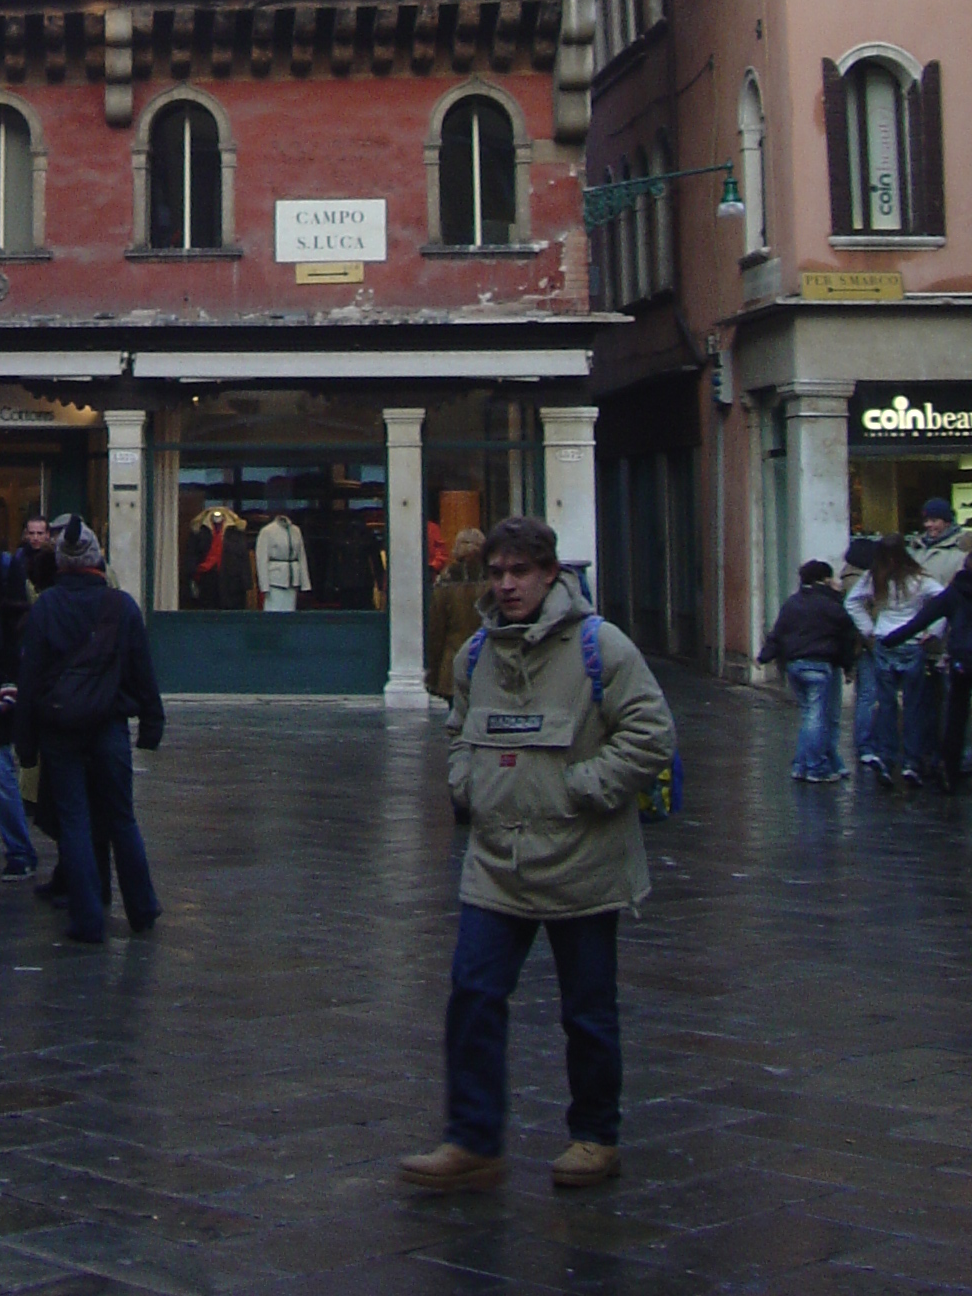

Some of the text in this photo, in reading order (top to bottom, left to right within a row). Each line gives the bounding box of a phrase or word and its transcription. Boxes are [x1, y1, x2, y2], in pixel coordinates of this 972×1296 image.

[296, 210, 364, 225] CAMPO
[296, 235, 365, 249] S.LUCA
[805, 275, 832, 286] PER
